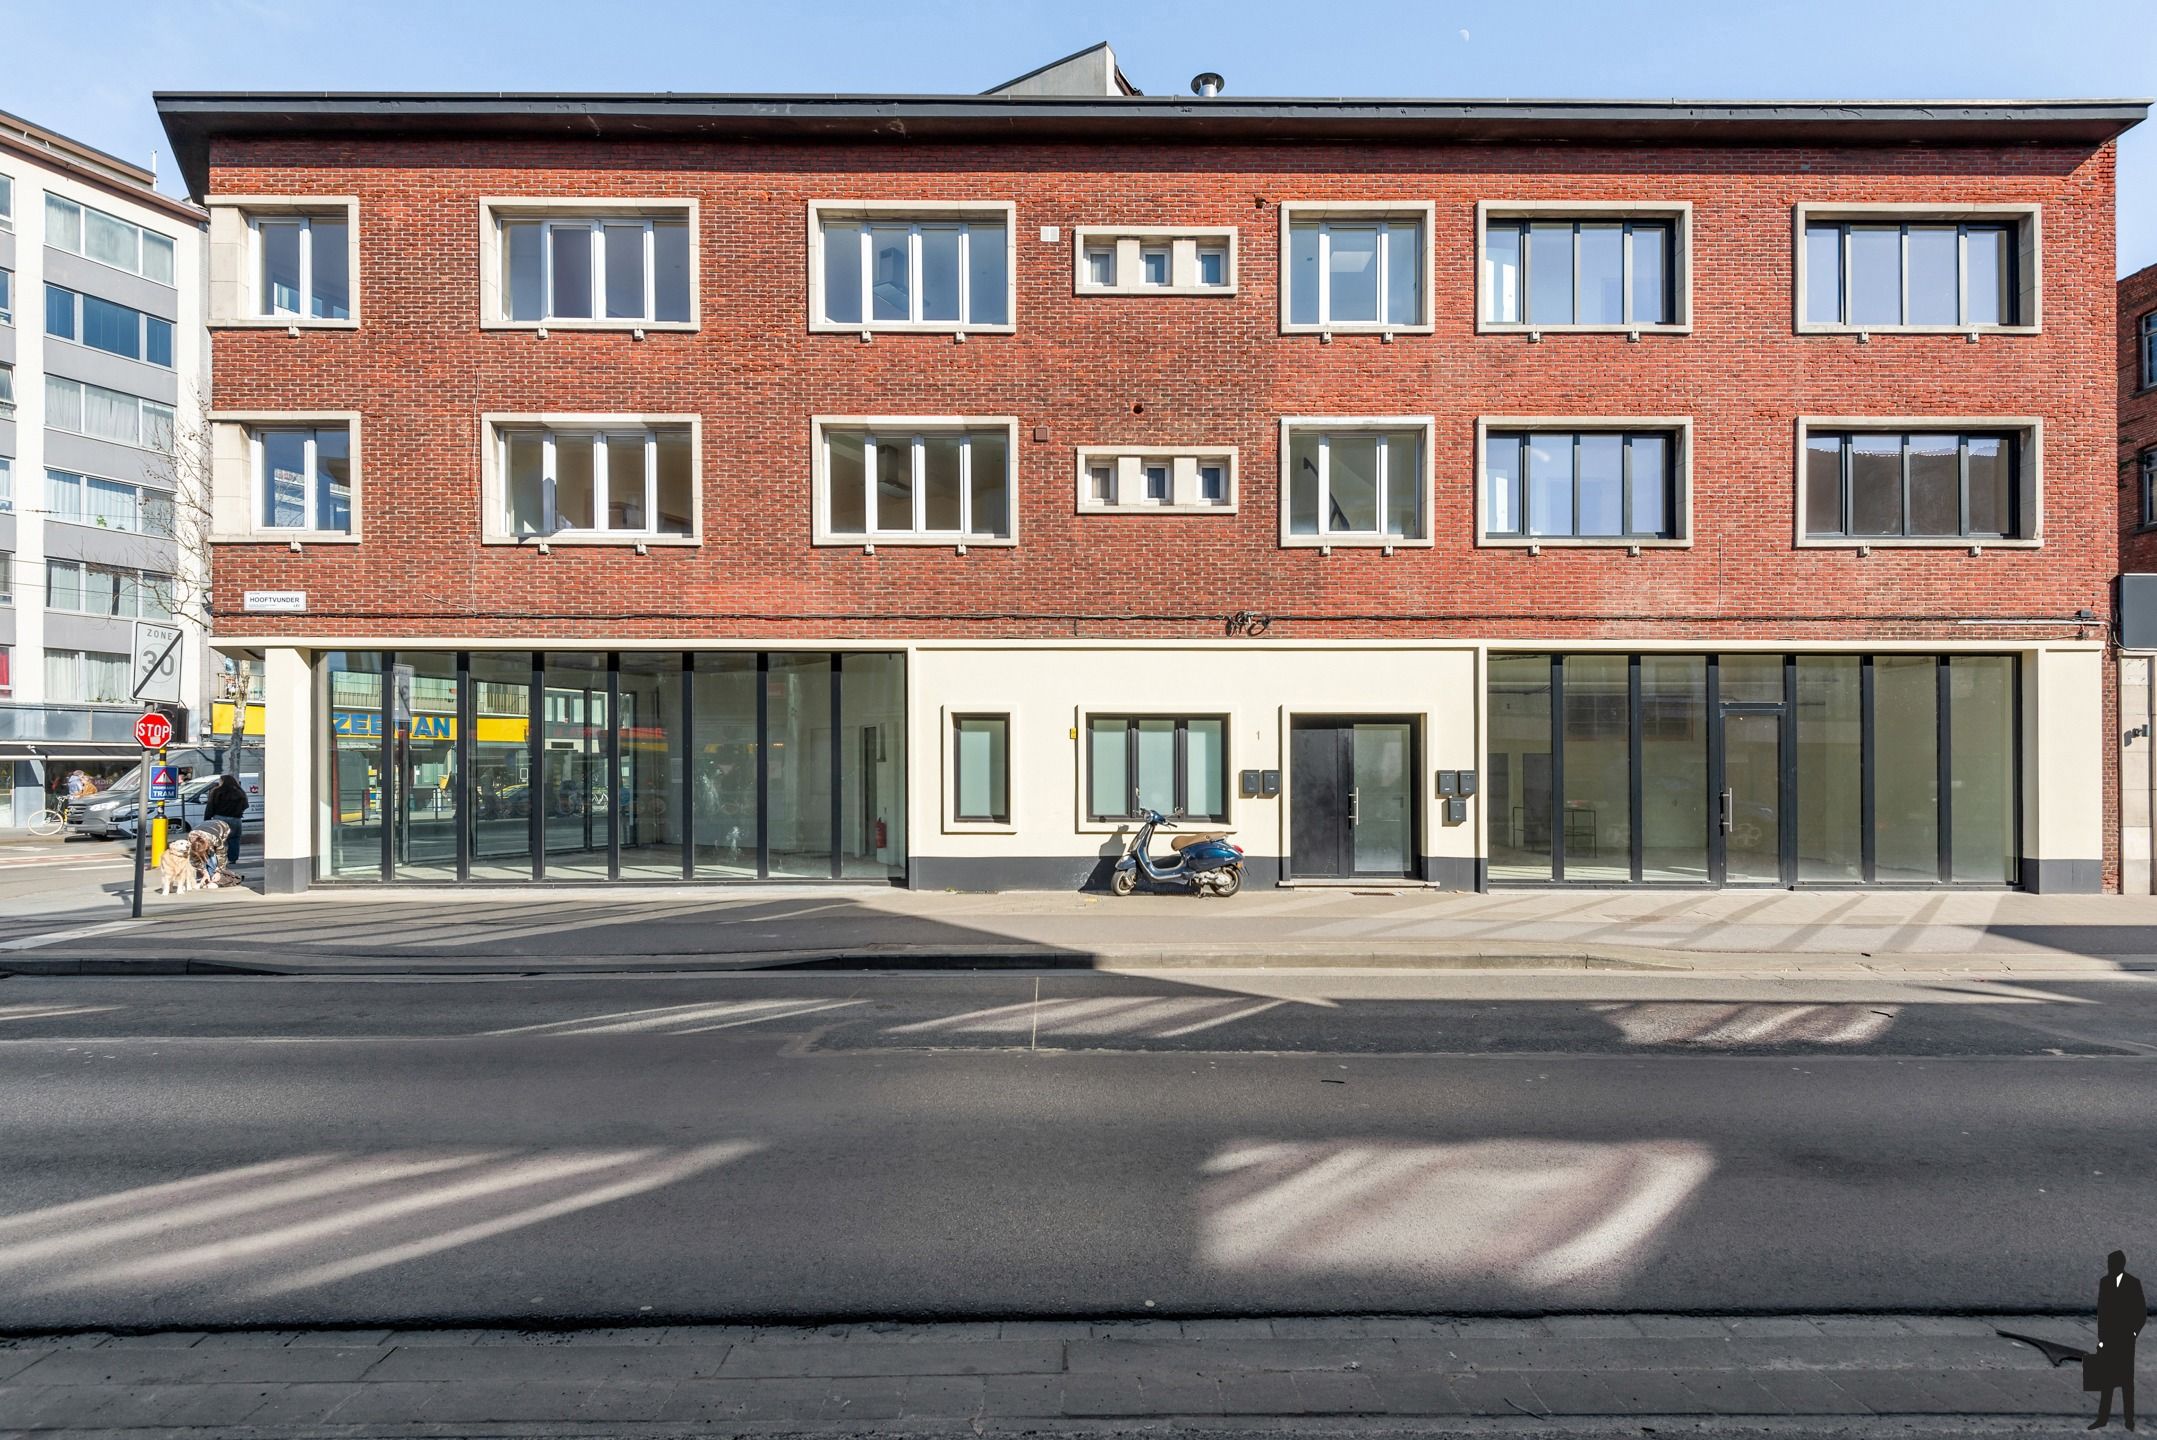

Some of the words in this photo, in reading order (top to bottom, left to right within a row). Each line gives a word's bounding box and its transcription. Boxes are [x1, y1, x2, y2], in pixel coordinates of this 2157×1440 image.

[146, 628, 173, 641] ZONE
[142, 650, 174, 676] 30
[138, 723, 170, 739] STOP
[333, 713, 451, 737] ZEEAN
[153, 790, 175, 798] TRAM
